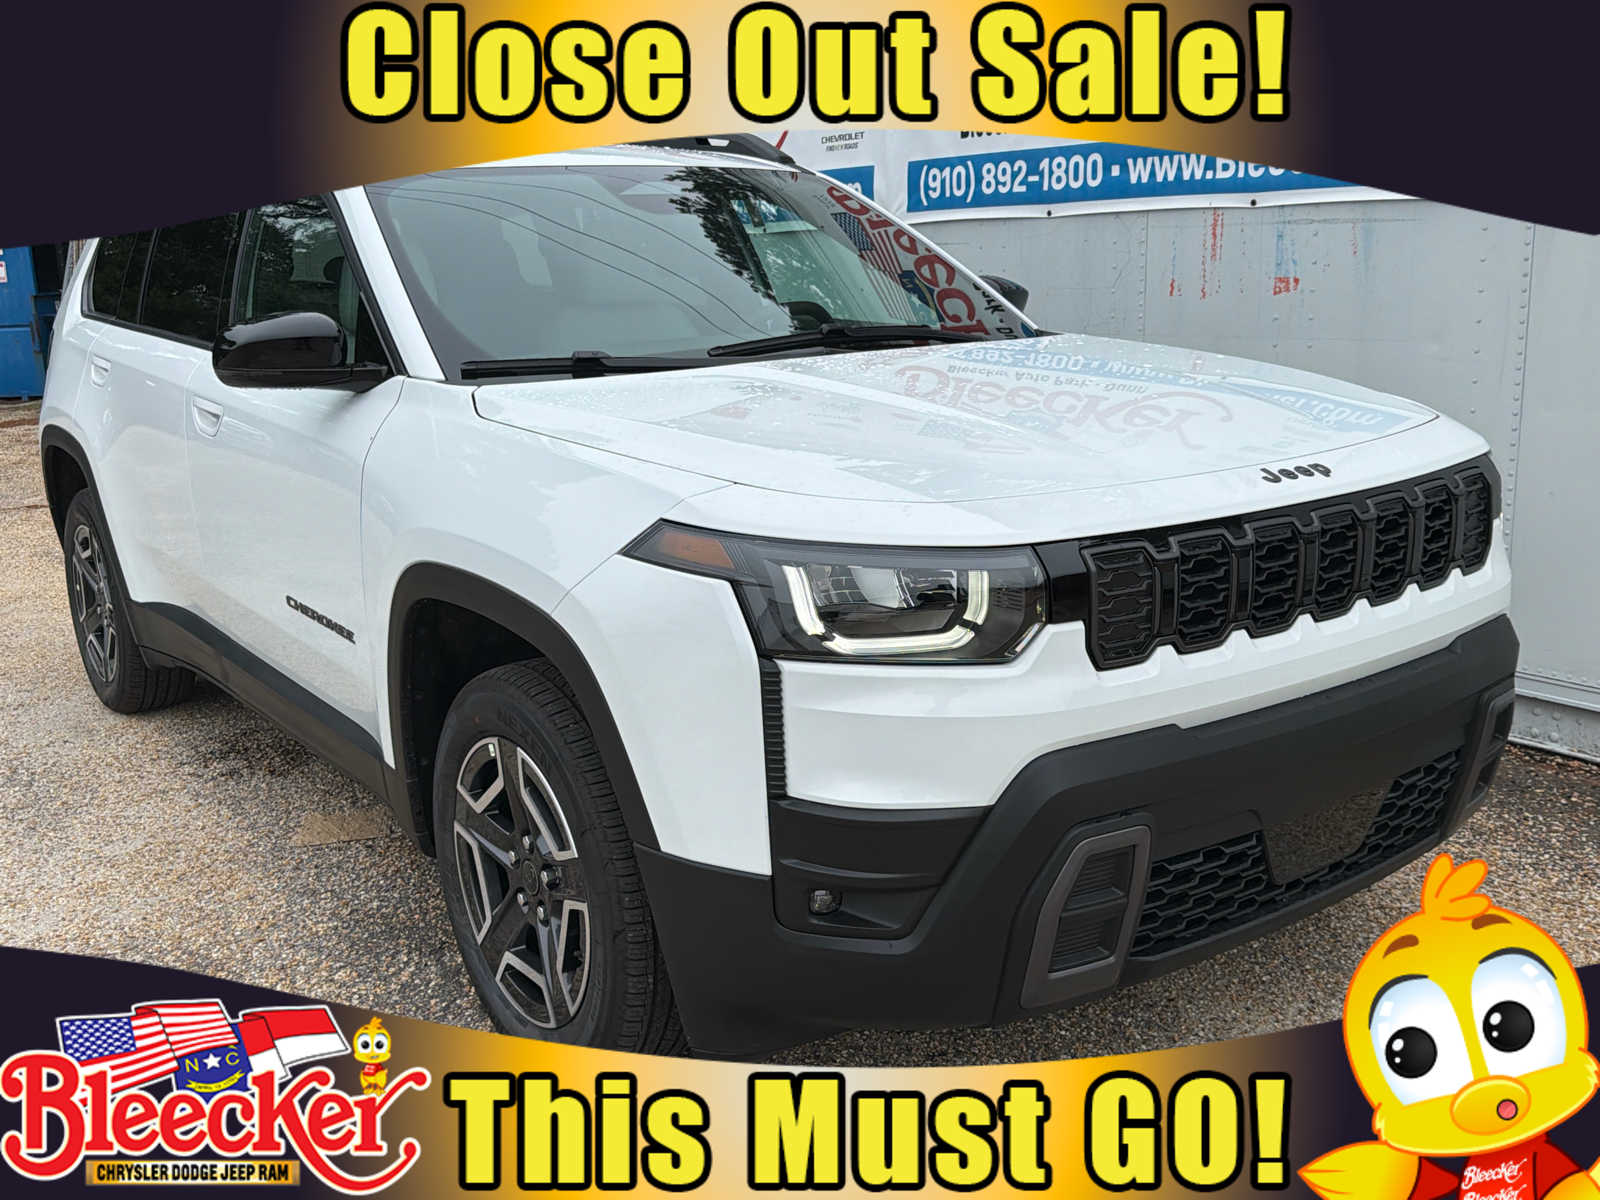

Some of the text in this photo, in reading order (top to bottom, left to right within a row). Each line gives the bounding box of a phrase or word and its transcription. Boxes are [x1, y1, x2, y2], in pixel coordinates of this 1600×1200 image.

[820, 131, 865, 144] CHEVROLET
[920, 160, 976, 206] (910)
[981, 152, 1103, 195] 892-1800
[1259, 462, 1333, 483] Jeep
[285, 594, 357, 645] CHEROKEE
